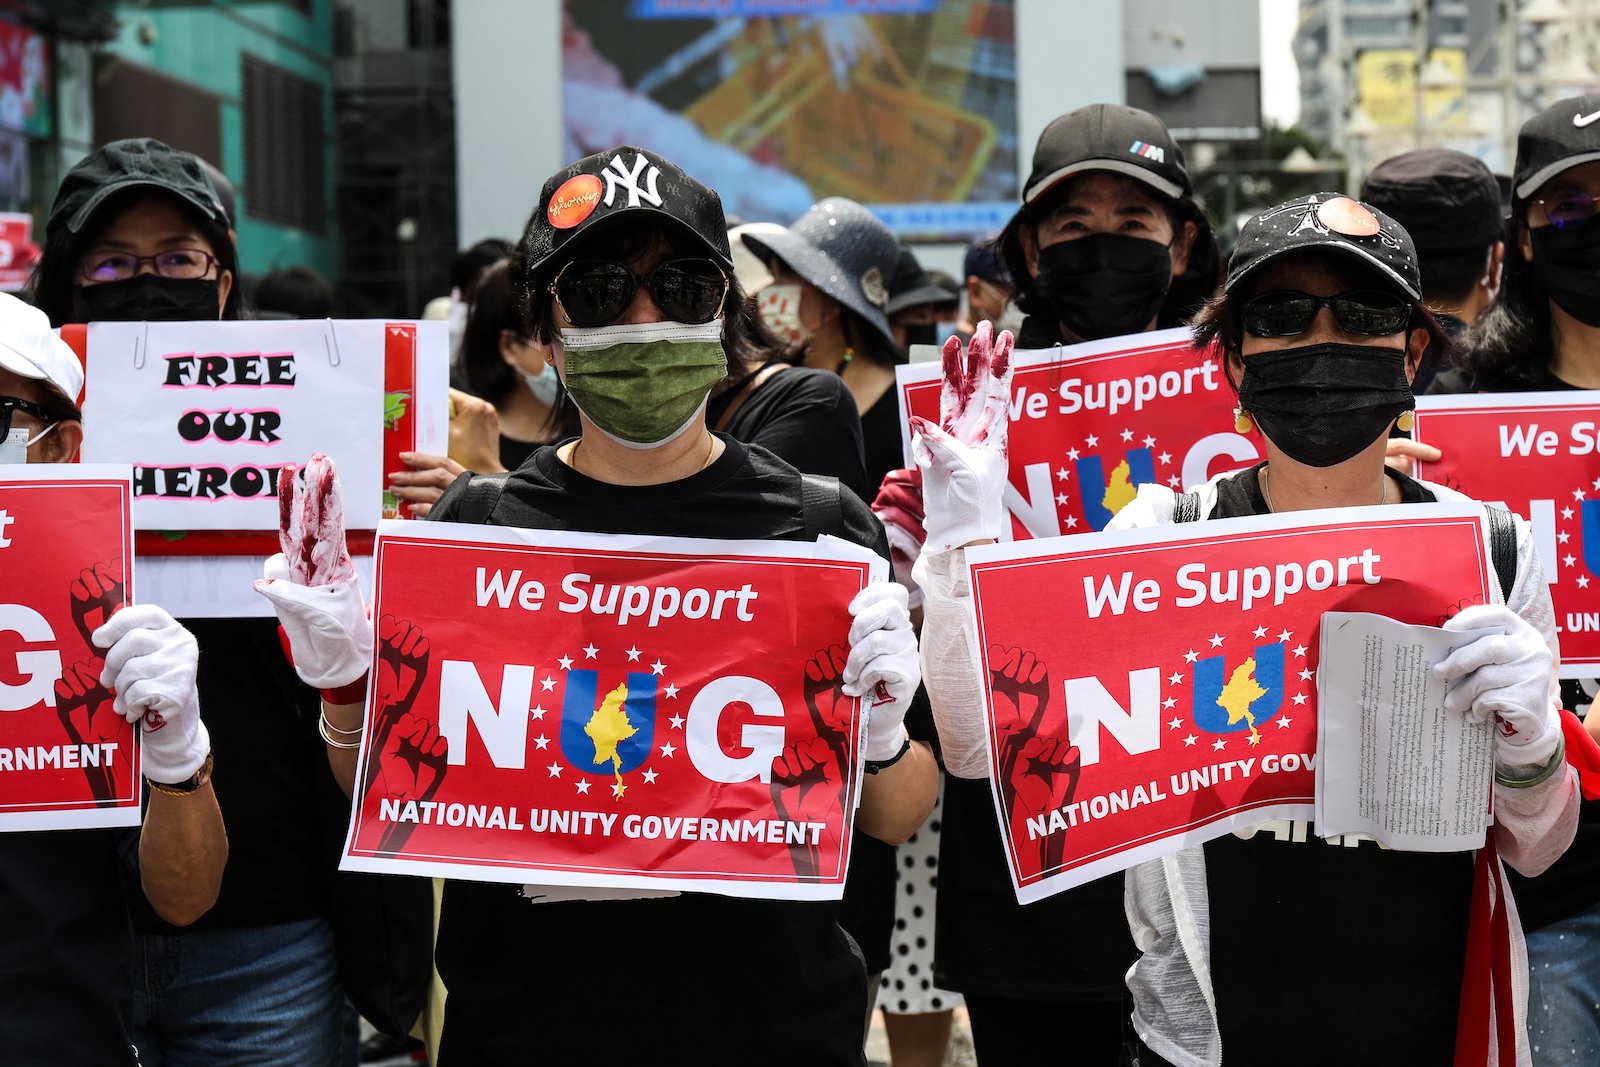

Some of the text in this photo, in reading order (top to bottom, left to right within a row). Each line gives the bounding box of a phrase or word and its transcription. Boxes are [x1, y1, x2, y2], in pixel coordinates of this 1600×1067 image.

[600, 152, 663, 208] NY
[162, 352, 297, 389] FREE
[1058, 359, 1219, 416] Support
[177, 408, 282, 444] OUR
[1498, 423, 1559, 457] We
[133, 464, 307, 501] HERO
[476, 567, 759, 628] We Support
[1083, 547, 1382, 619] We Support
[438, 659, 786, 785] NUG
[379, 798, 827, 846] NATIONAL UNITY GOVERNMENT
[1026, 780, 1168, 841] NATIONAL
[1170, 757, 1256, 796] UNITY
